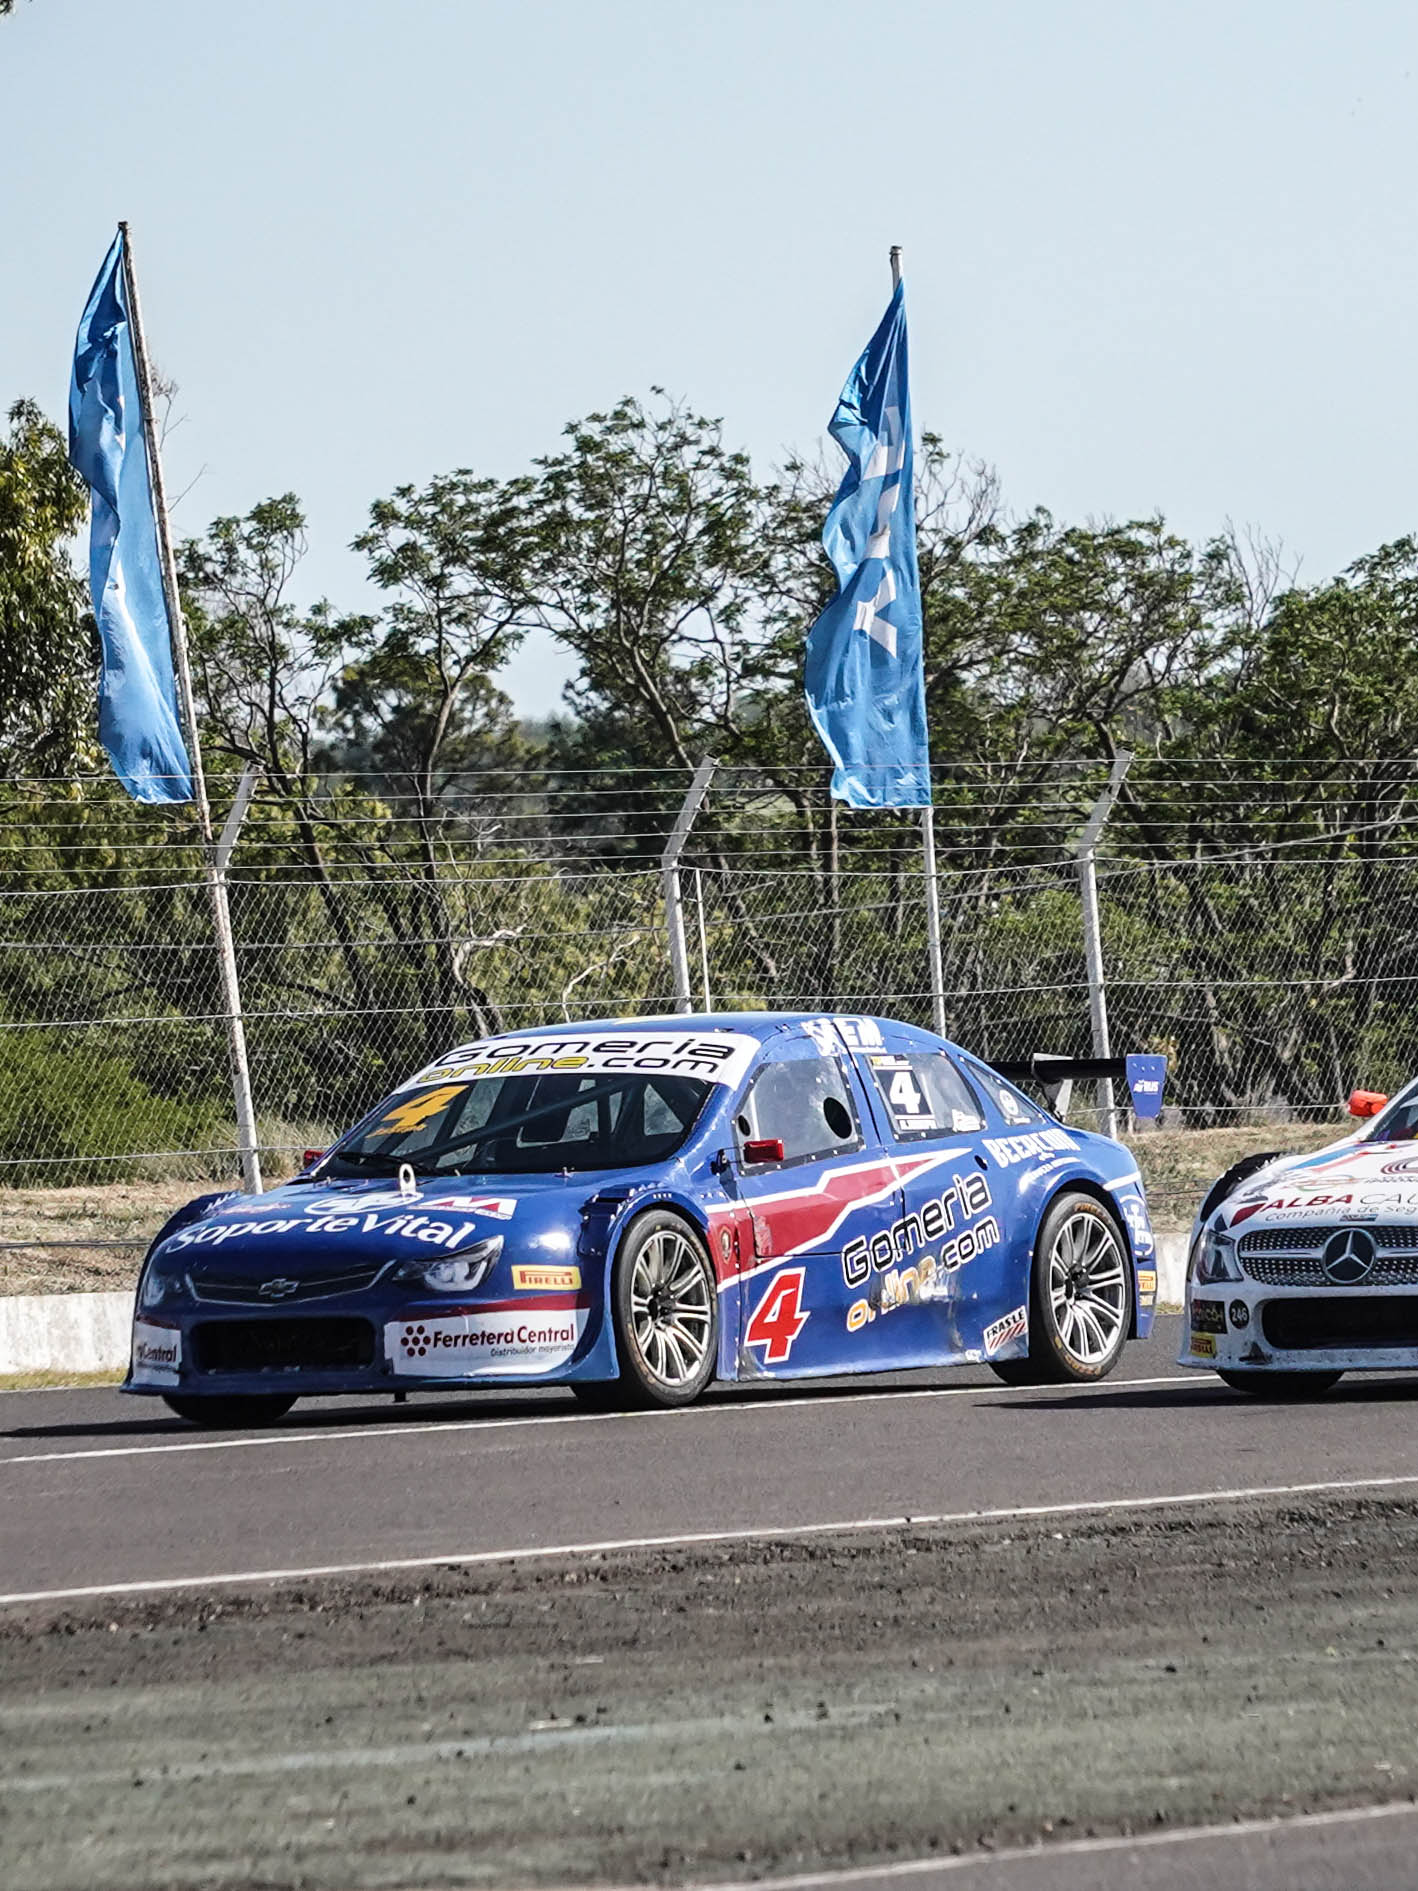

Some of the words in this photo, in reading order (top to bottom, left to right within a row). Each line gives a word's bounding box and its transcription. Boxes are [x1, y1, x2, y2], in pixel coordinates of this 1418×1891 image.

[434, 1038, 737, 1068] Gomeria
[417, 1055, 719, 1083] online.com
[381, 1084, 470, 1128] 4
[889, 1071, 921, 1114] 4
[1260, 1194, 1354, 1213] ALBA
[1357, 1203, 1380, 1214] de
[841, 1171, 993, 1289] Gomeria
[519, 1270, 574, 1286] PIRELLI
[744, 1266, 812, 1365] 4
[1231, 1307, 1248, 1322] 246
[517, 1323, 574, 1344] Central
